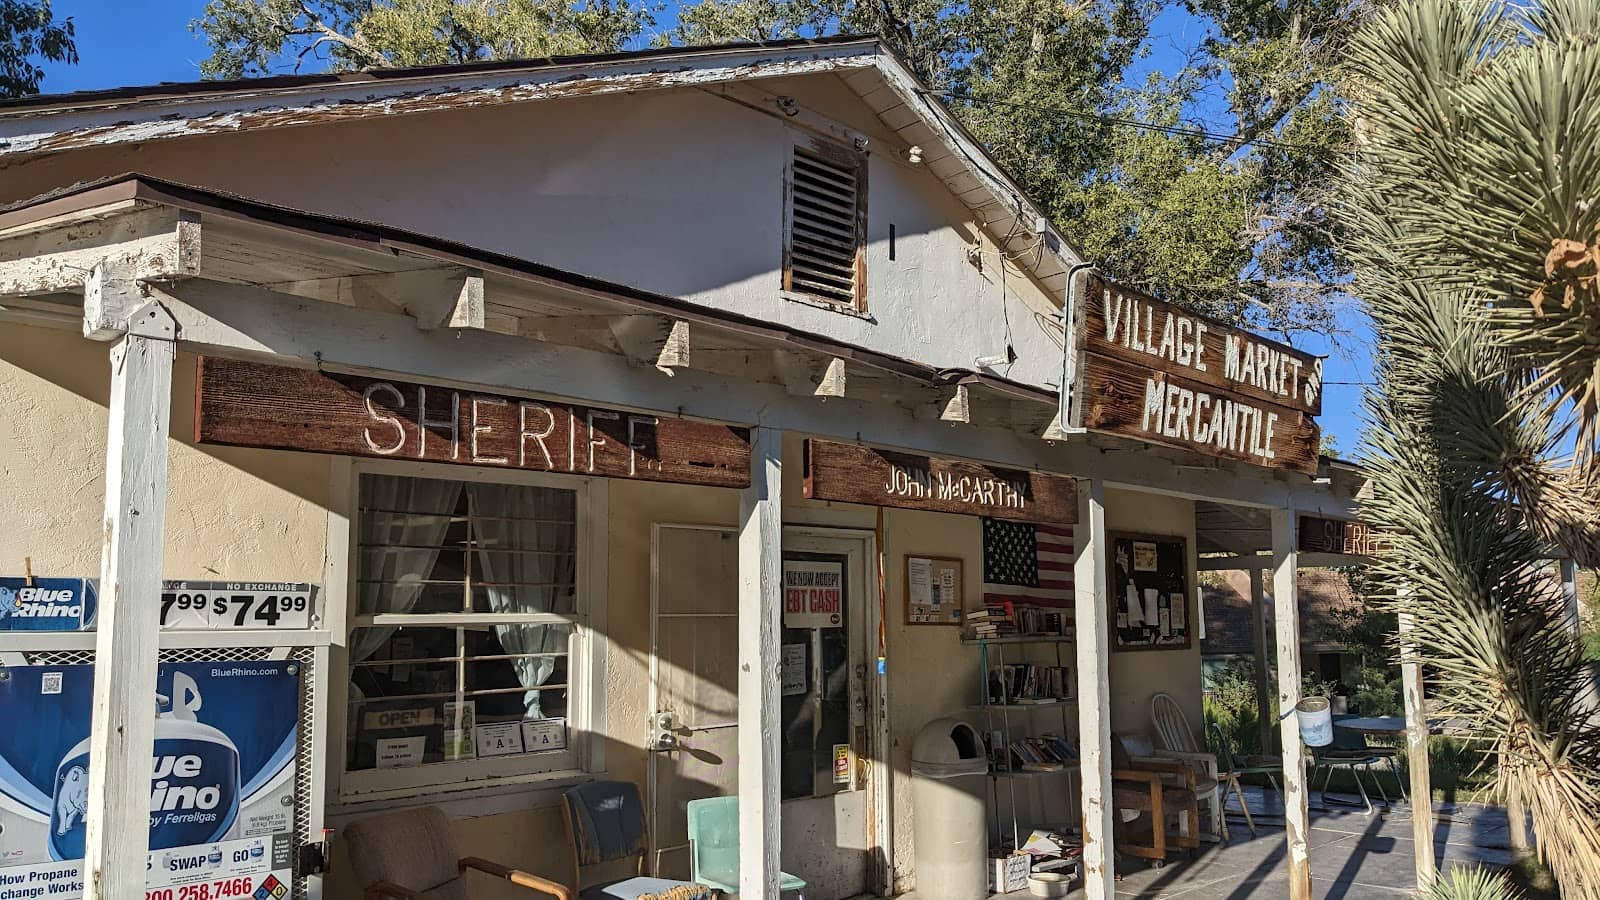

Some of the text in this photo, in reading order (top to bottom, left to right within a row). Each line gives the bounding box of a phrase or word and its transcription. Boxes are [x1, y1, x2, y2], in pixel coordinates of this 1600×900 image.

[1103, 289, 1207, 372] VILLAGE
[1224, 335, 1303, 400] MARKET
[1142, 379, 1278, 459] MERCANTILE
[362, 382, 659, 476] SHERIFF
[885, 464, 932, 498] JOHN
[245, 583, 297, 591] EXCHANGE
[799, 571, 814, 586] NOW
[815, 572, 840, 587] ACCEPT
[19, 587, 74, 602] Blue
[786, 588, 840, 613] EBT CASH
[11, 602, 82, 617] Rhino
[211, 668, 278, 677] BlueRhino.com
[378, 710, 420, 726] OPEN
[496, 738, 504, 748] A
[151, 754, 202, 780] ue
[150, 780, 220, 812] ino
[164, 812, 217, 825] Ferrellgas
[170, 854, 207, 871] SWAP
[233, 849, 249, 863] GO
[0, 868, 78, 886] How Propane
[48, 881, 84, 895] Works
